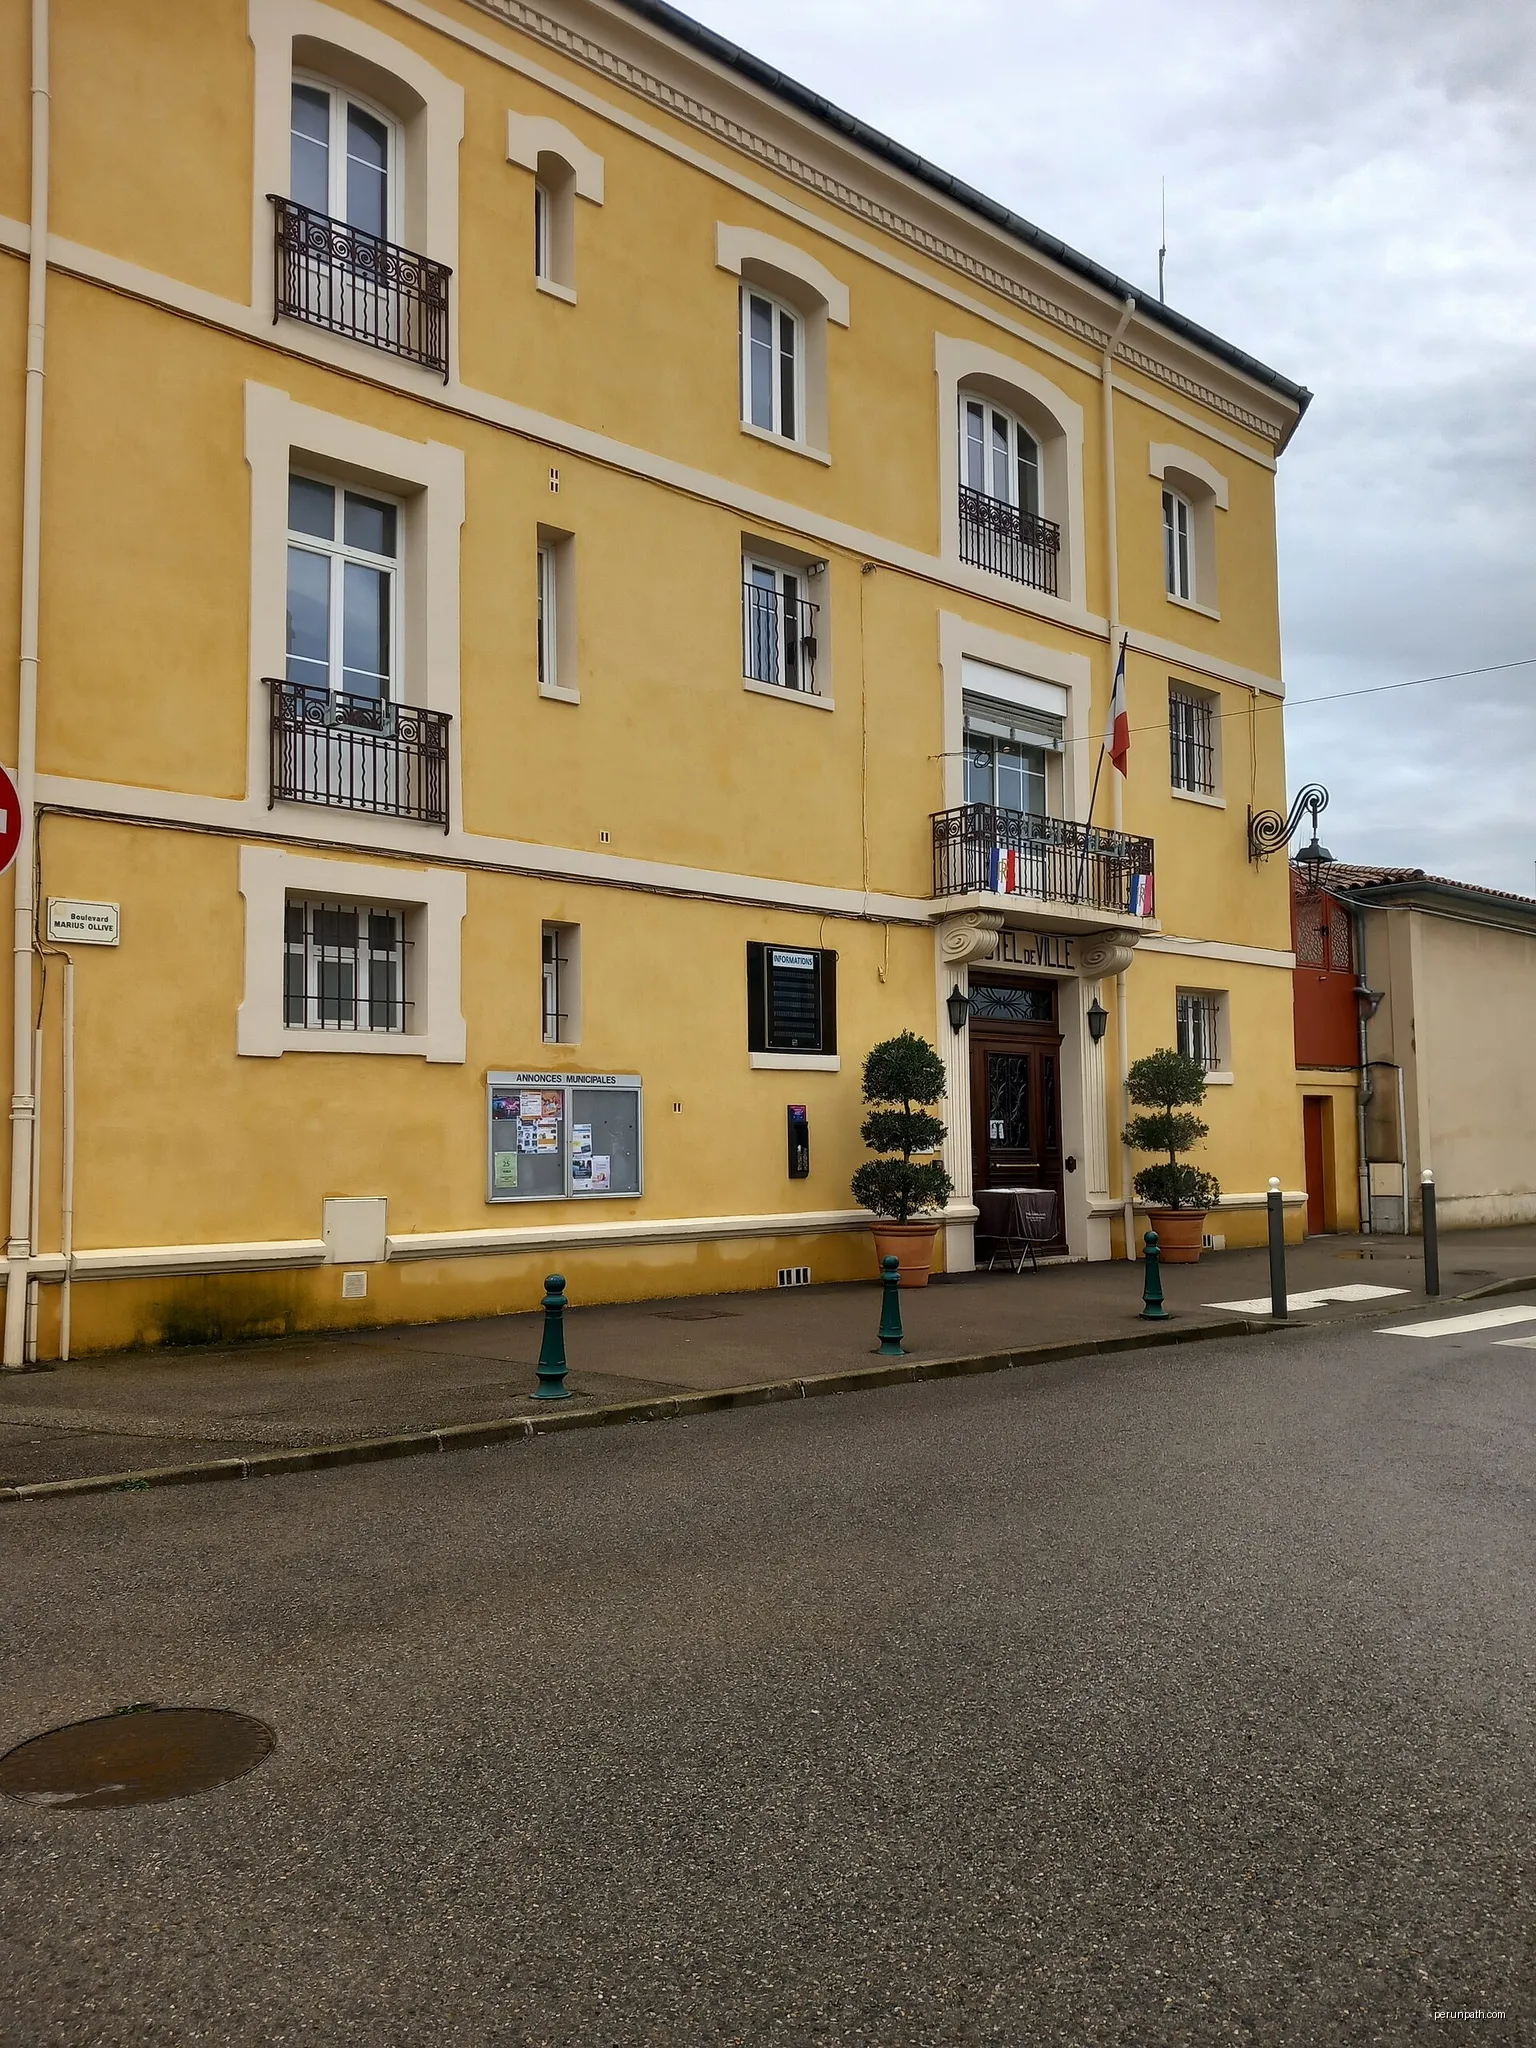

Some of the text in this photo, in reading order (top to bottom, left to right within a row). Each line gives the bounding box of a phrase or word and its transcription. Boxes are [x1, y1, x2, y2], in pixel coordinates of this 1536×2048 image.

[70, 913, 109, 922] Boulevard
[54, 920, 114, 932] MARIUS OLLIVE
[1024, 949, 1036, 965] DE
[1035, 935, 1075, 970] VILLE
[774, 955, 812, 965] INFORMATIONS
[516, 1074, 617, 1084] ANNONCES MUNICIPALES
